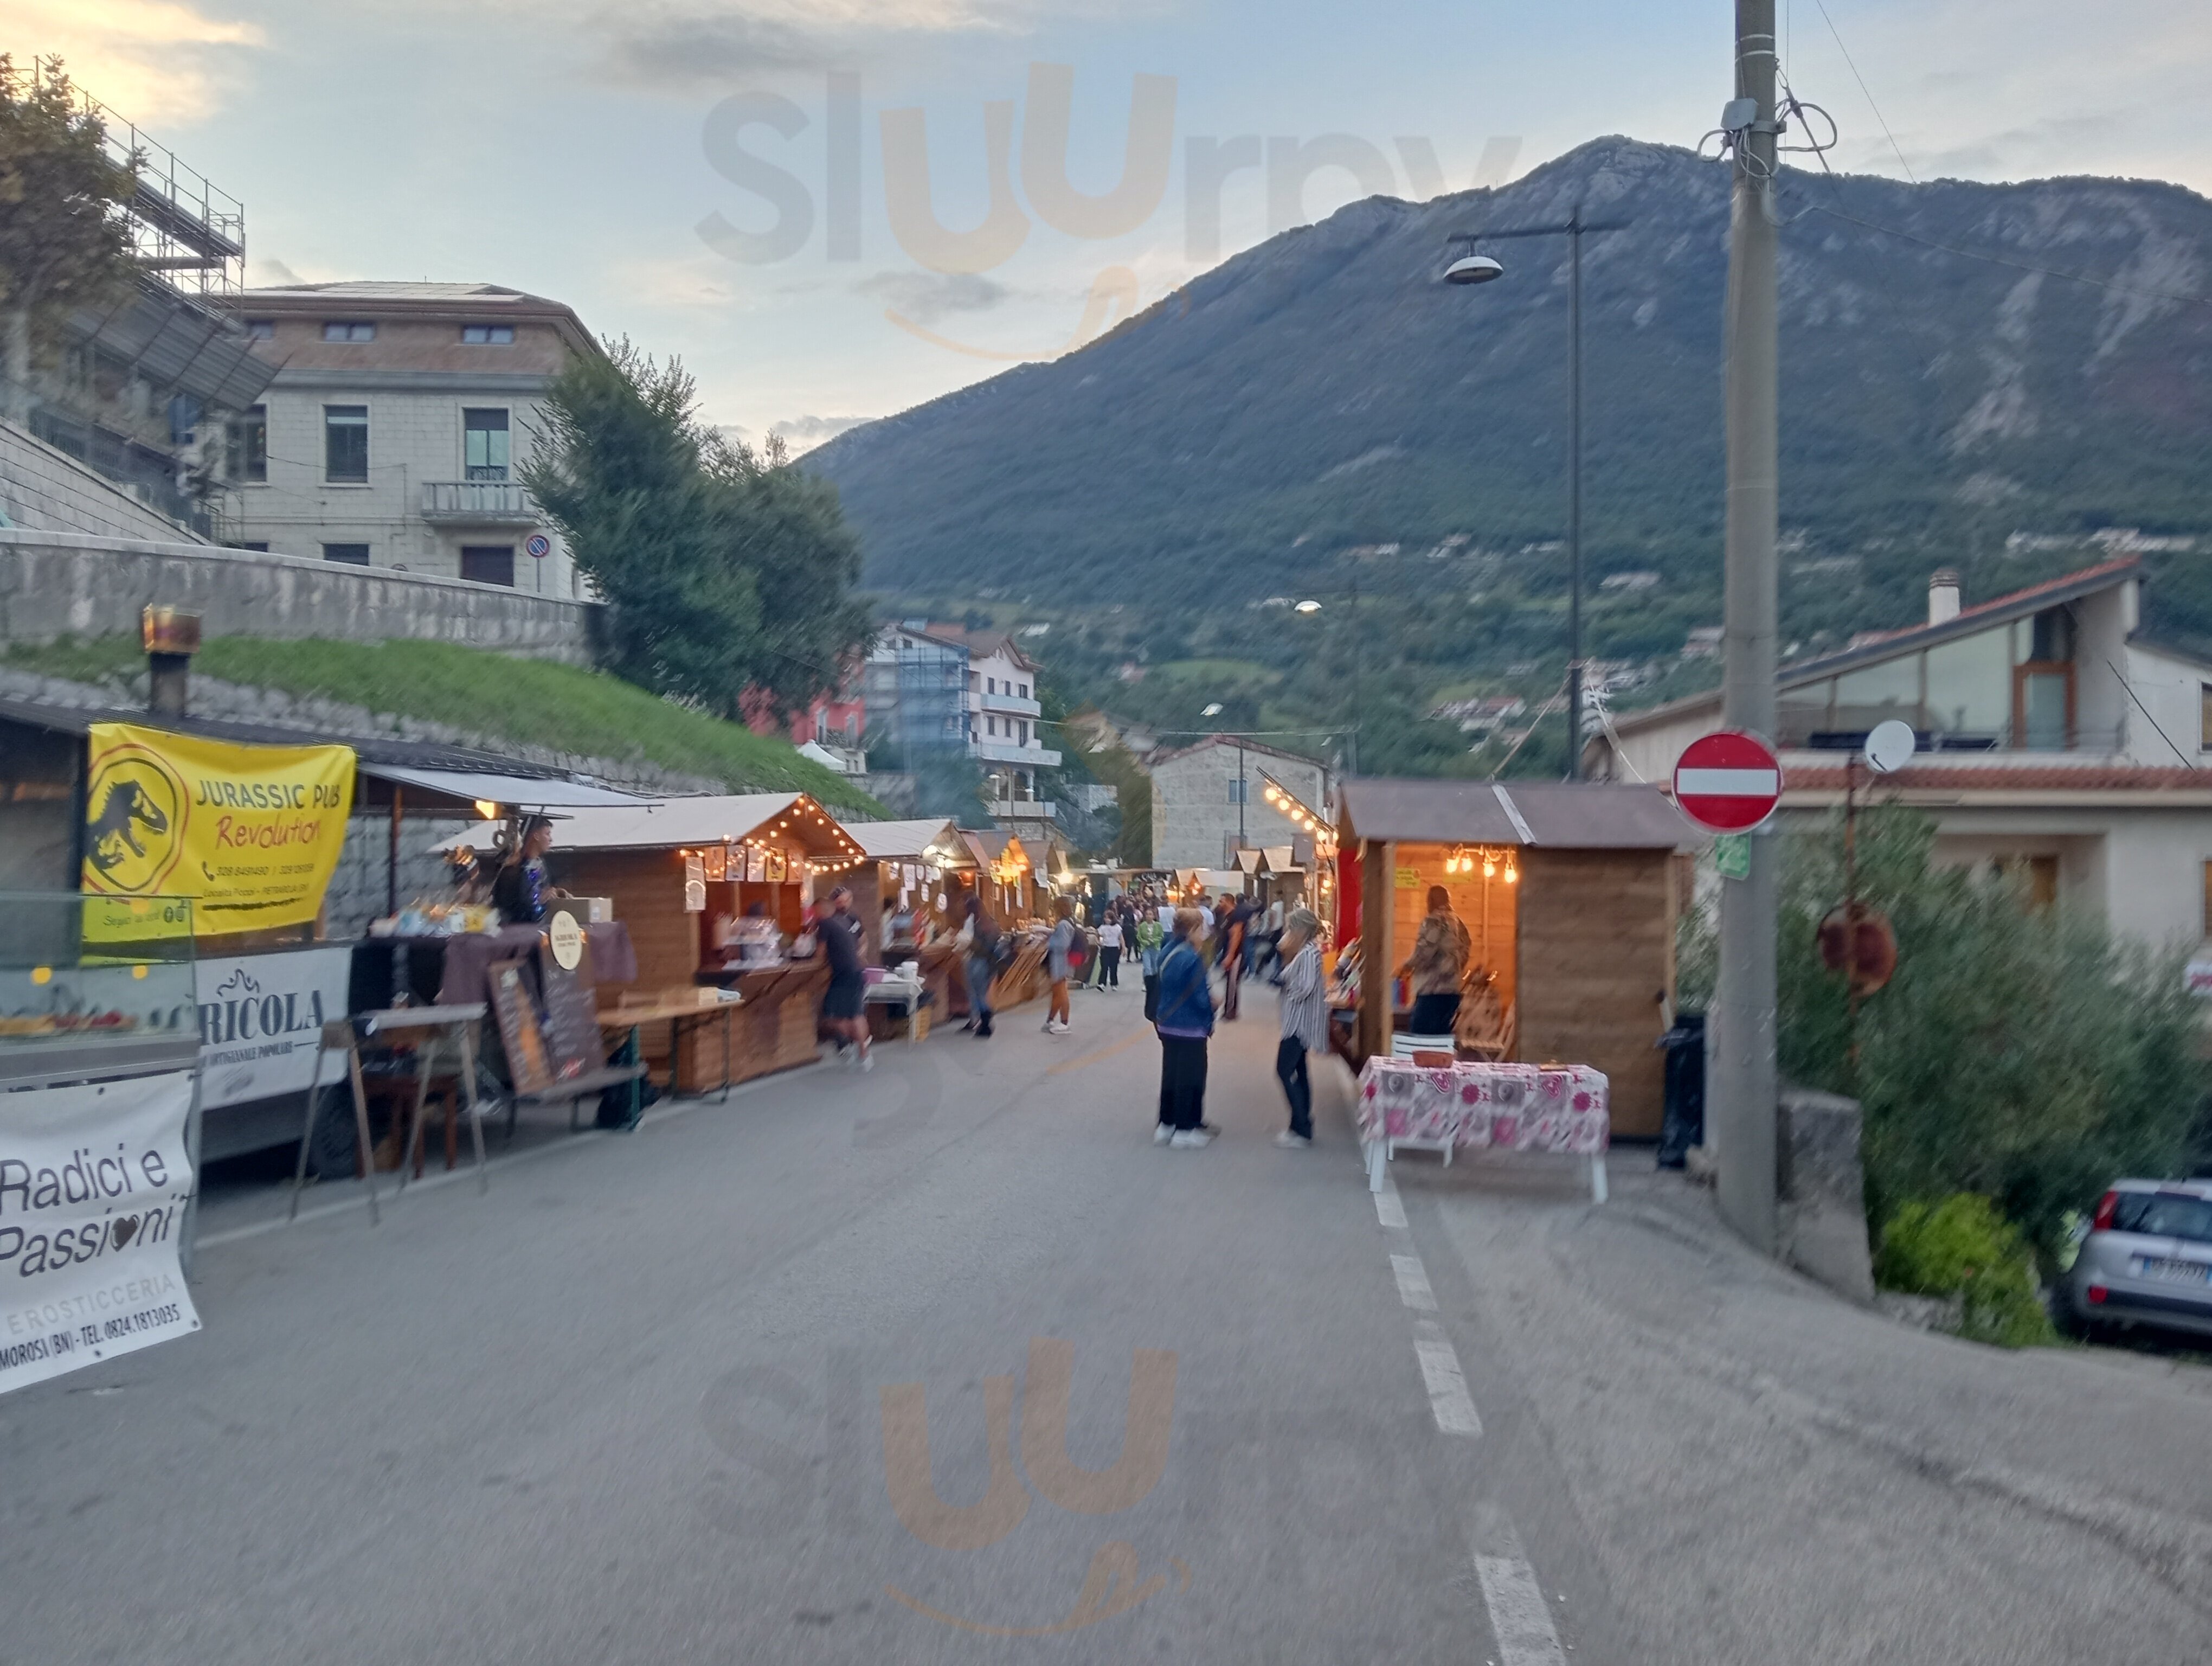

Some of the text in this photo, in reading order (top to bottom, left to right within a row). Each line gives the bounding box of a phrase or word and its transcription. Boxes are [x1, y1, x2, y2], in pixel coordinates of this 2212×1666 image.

[196, 780, 340, 809] JURASSIC PUB
[215, 813, 321, 850] Revolution
[0, 1143, 168, 1215] Radici e
[105, 1303, 181, 1340] 0824.1813035
